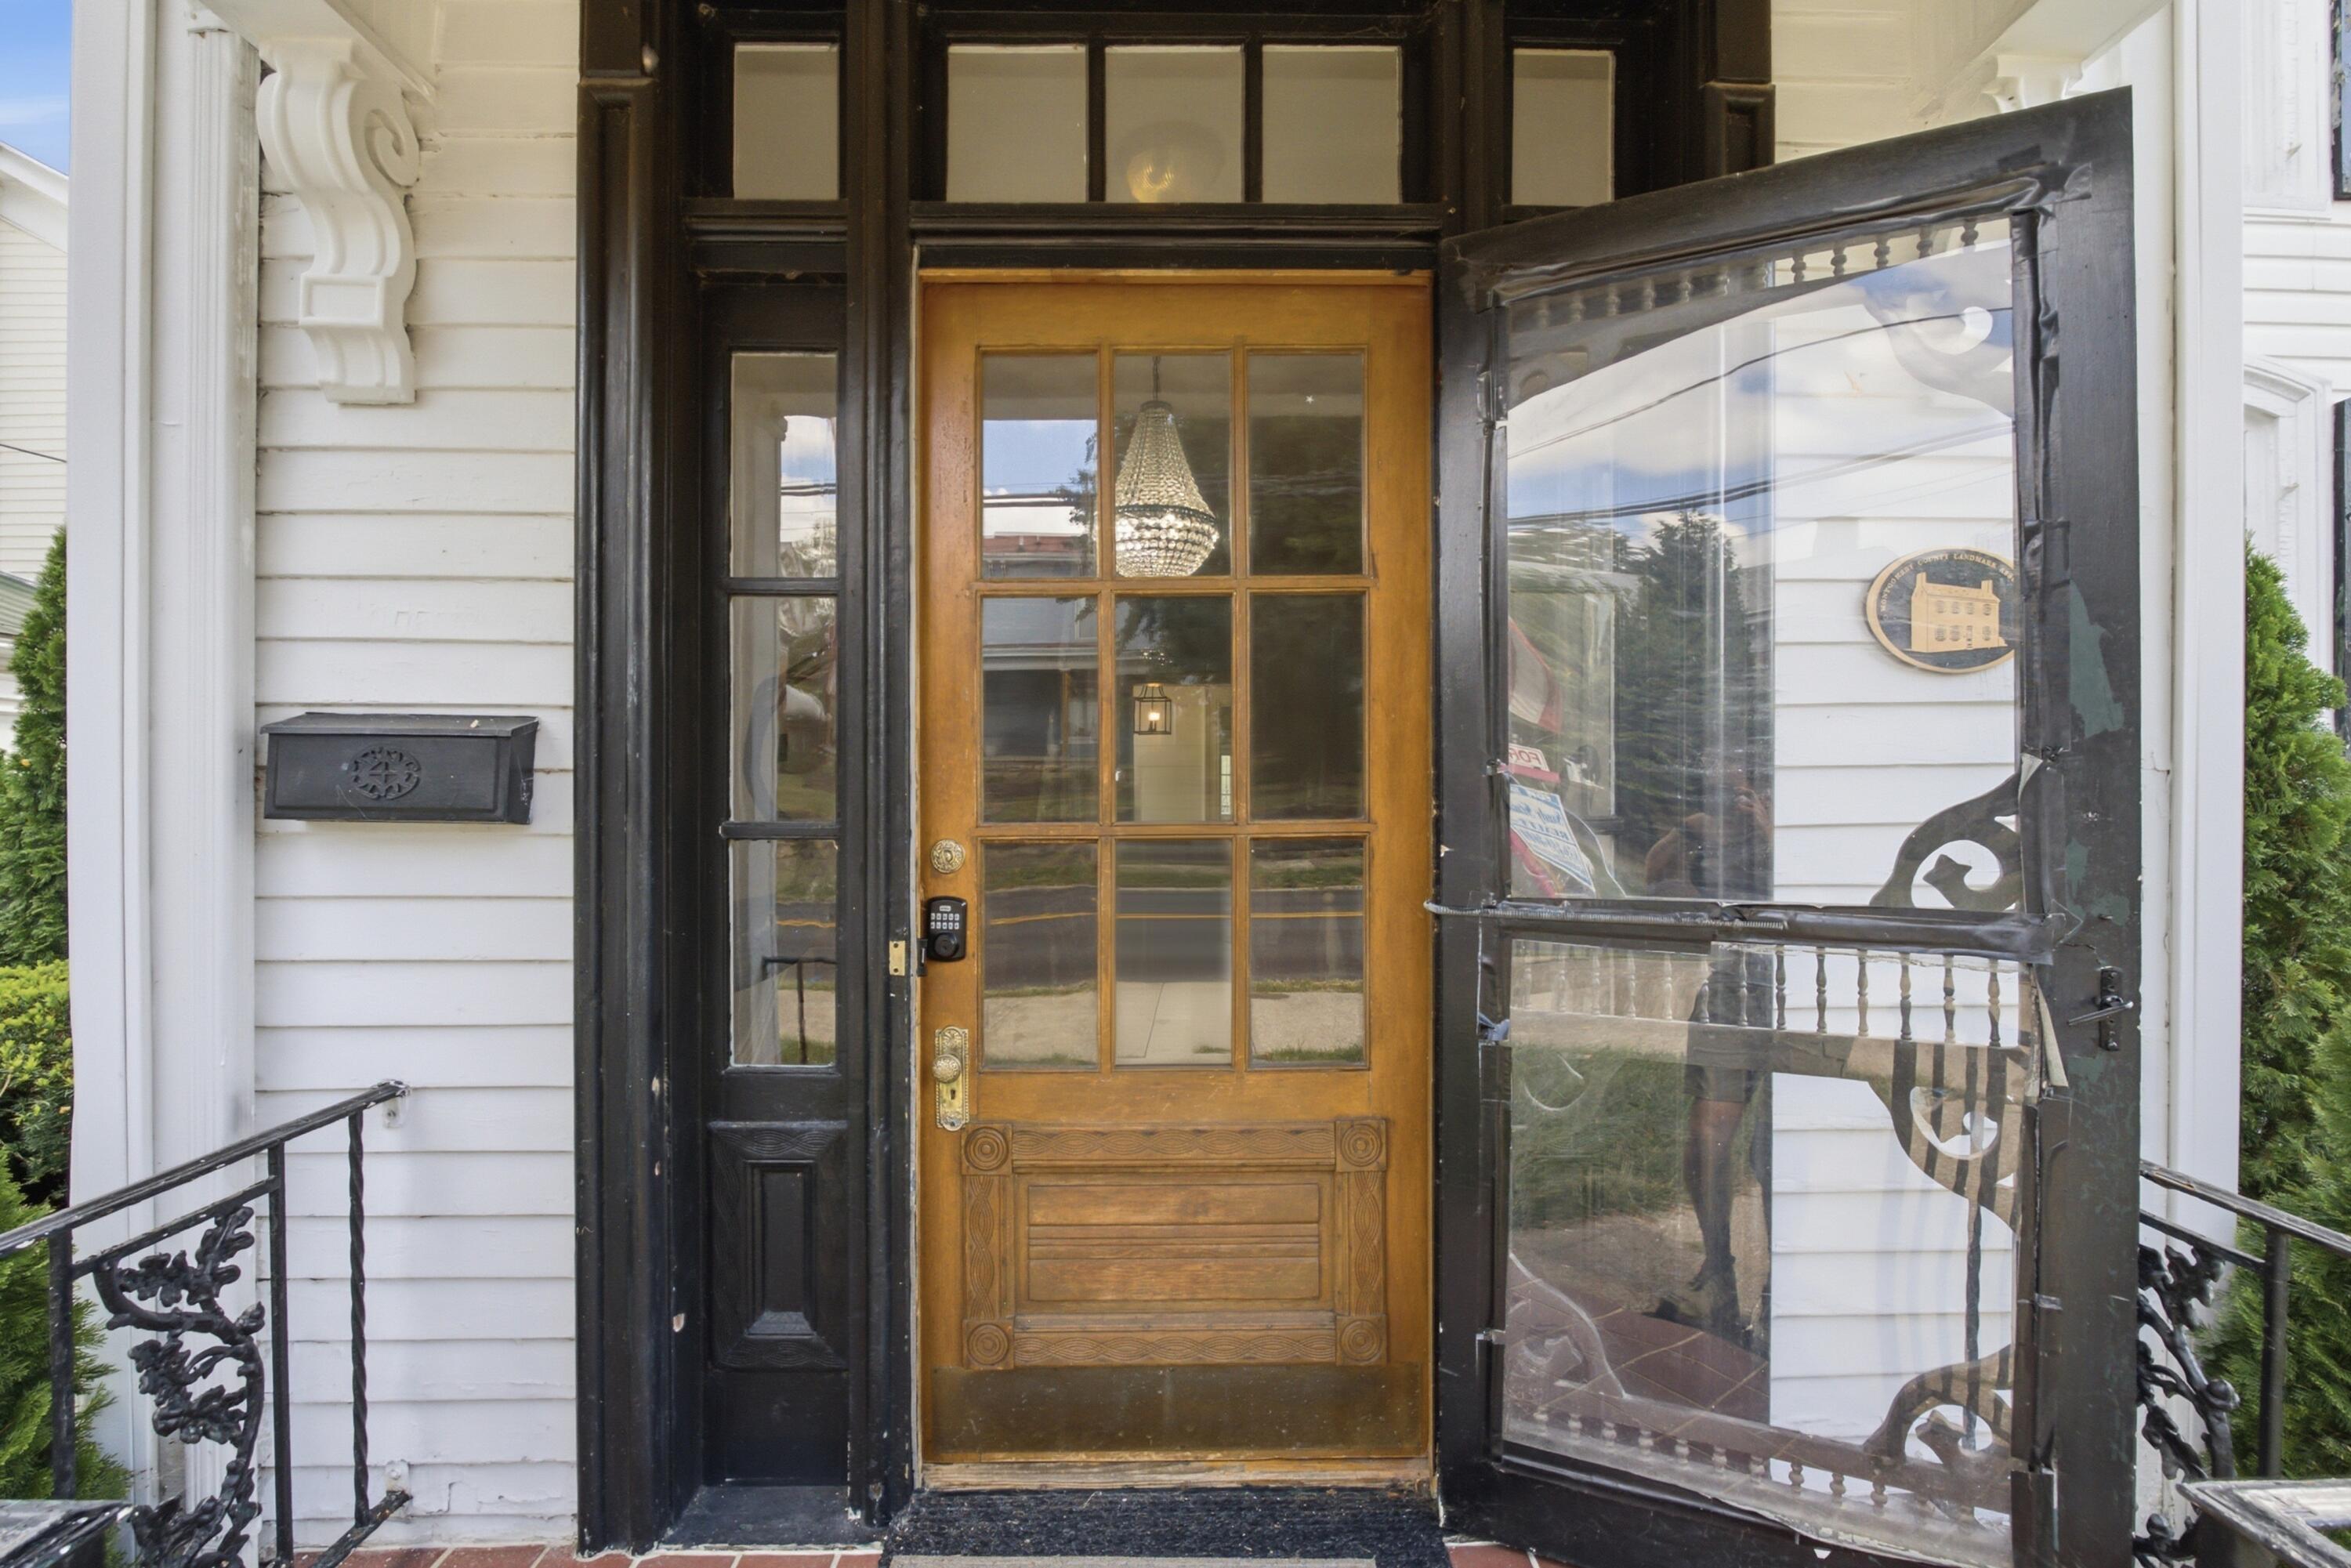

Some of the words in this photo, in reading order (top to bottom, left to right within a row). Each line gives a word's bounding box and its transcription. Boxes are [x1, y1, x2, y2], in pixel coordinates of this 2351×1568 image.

[1880, 563, 1914, 611] MONTGOMERY
[1918, 553, 1948, 565] COUNTY
[1953, 552, 1998, 568] LANDMARK
